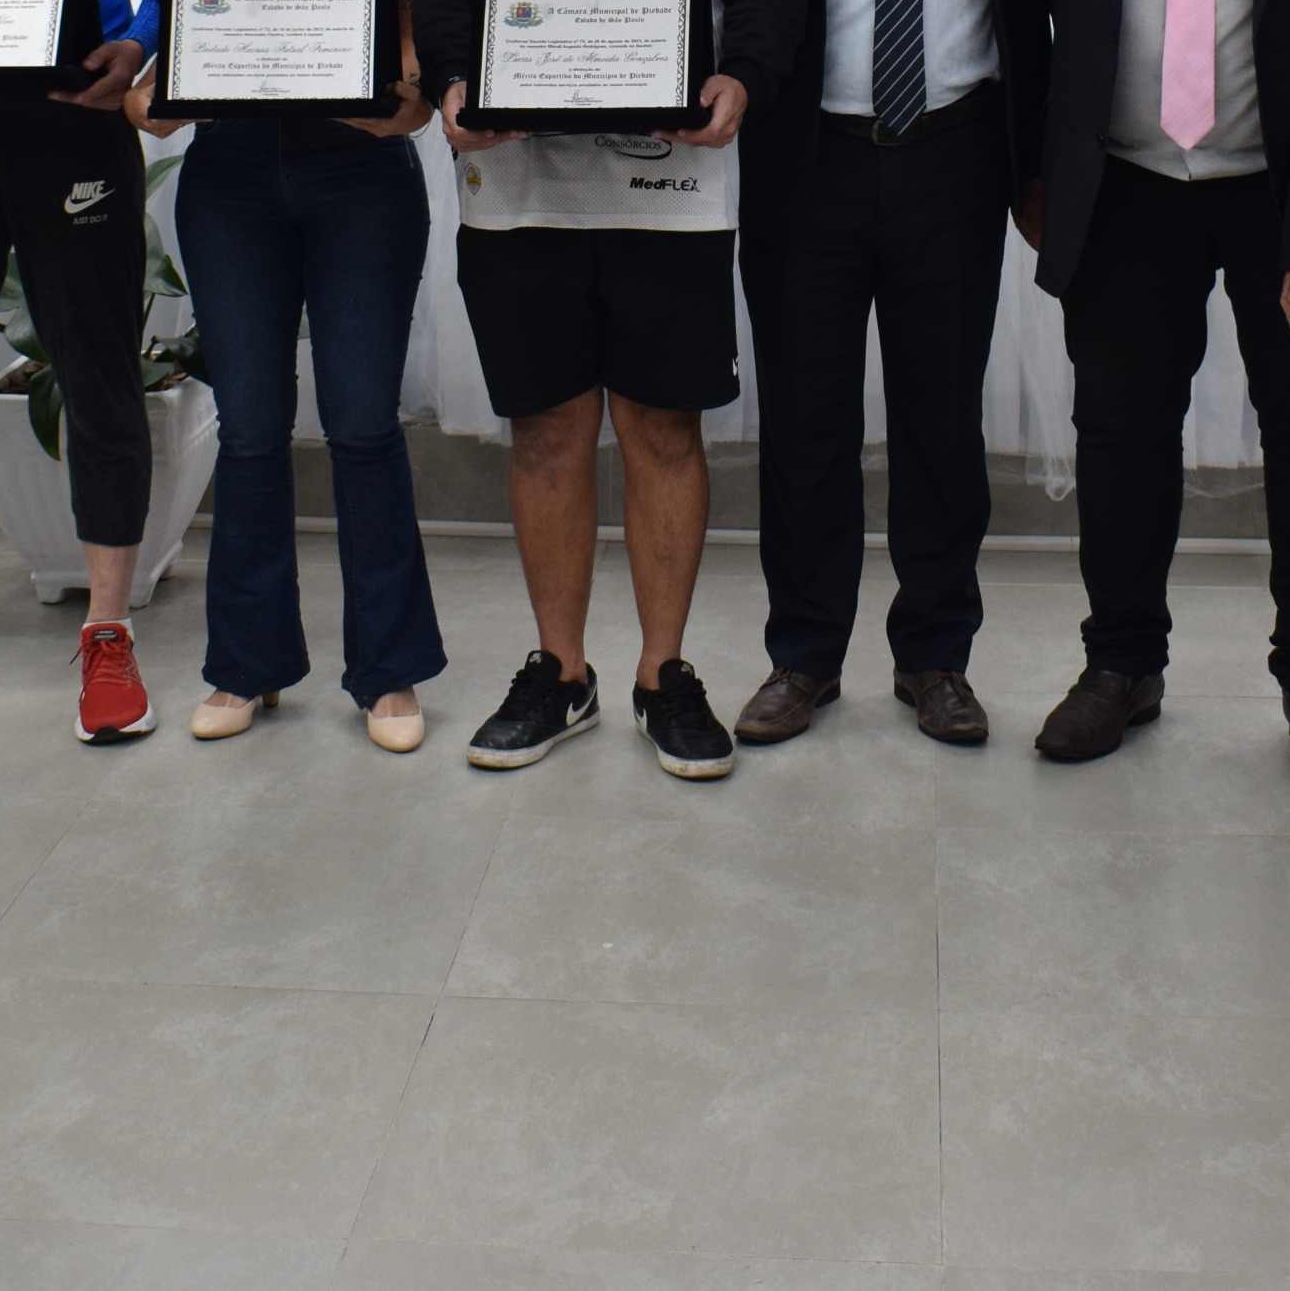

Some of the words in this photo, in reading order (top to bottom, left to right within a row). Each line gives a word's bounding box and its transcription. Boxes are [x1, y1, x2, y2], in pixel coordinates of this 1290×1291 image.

[595, 136, 661, 150] CONSÓRCIOS
[71, 180, 105, 200] NIKE
[630, 177, 701, 192] MedFLEX
[90, 215, 102, 223] DO
